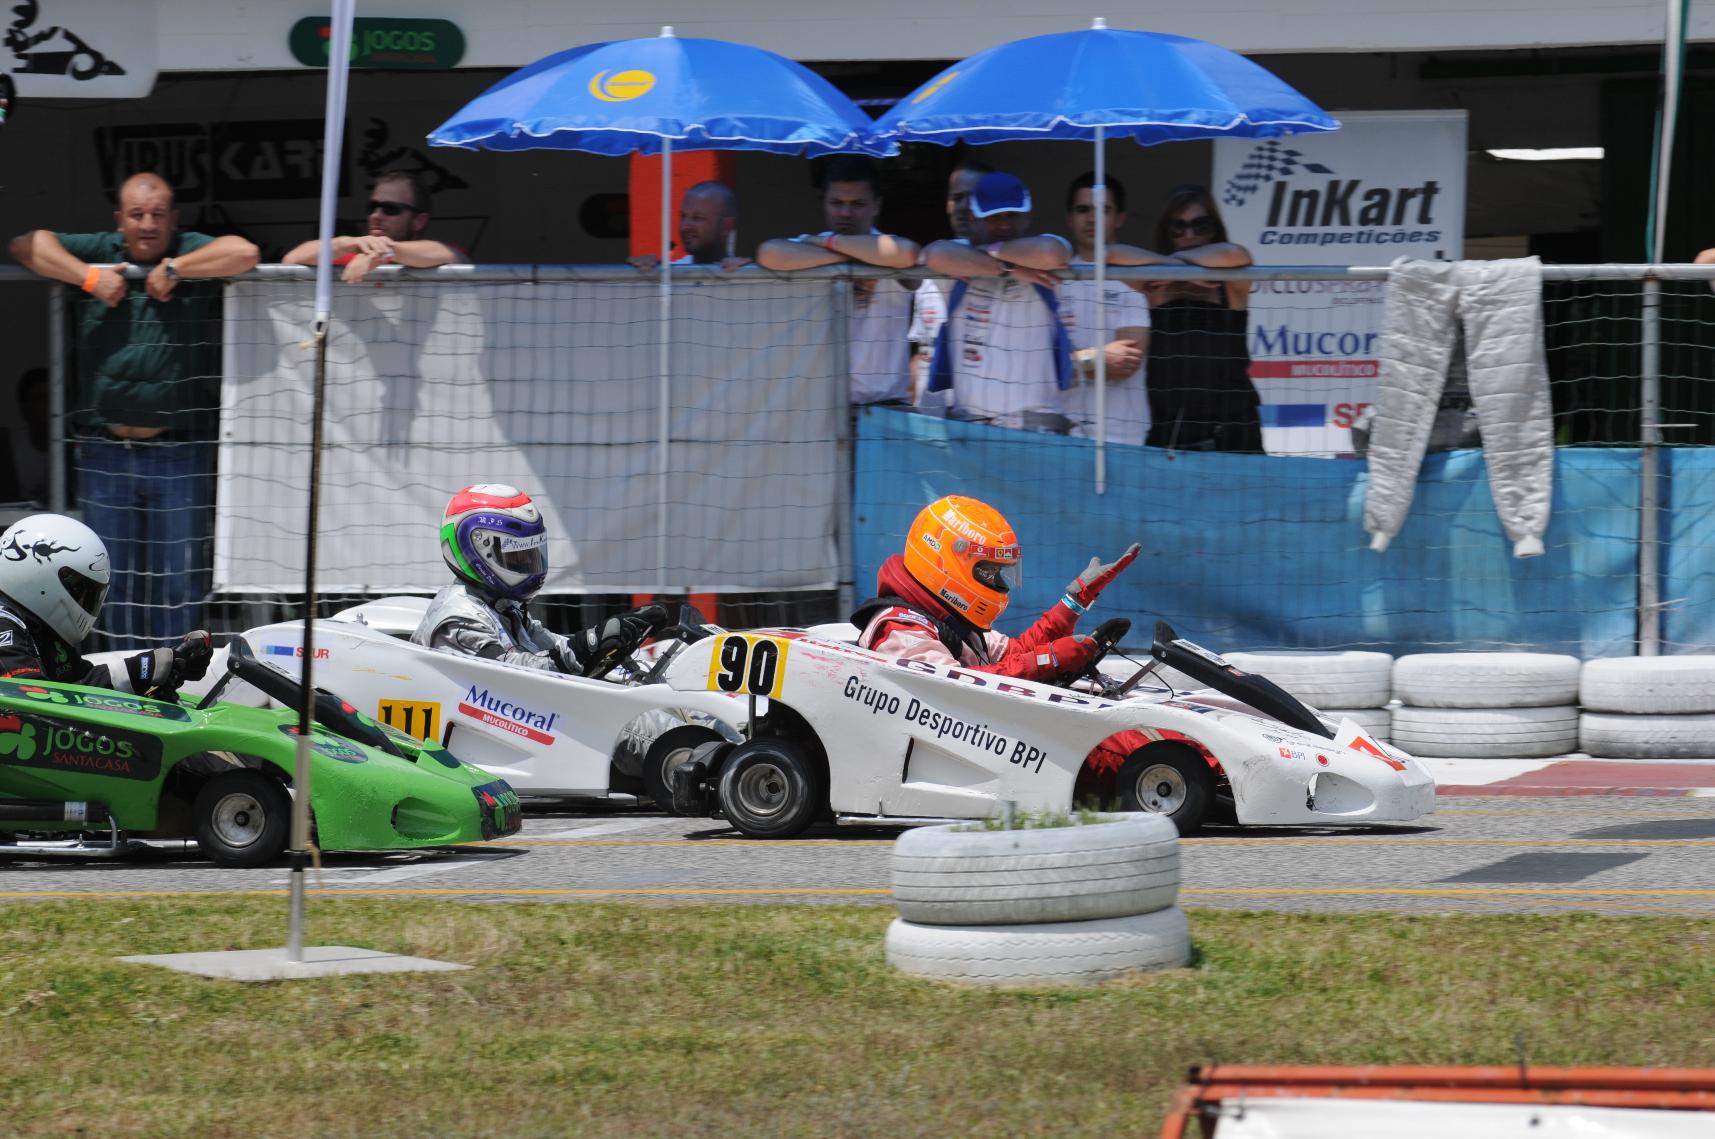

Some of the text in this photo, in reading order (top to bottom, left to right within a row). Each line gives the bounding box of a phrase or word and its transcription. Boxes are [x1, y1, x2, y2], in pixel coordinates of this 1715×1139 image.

[362, 30, 436, 55] JOGOS
[220, 140, 326, 180] KAR
[1265, 180, 1441, 227] InKart
[1250, 325, 1379, 355] Mucor
[941, 509, 987, 545] Marlboro
[940, 588, 969, 612] Marlboro
[295, 647, 330, 660] SUR
[717, 635, 779, 696] 90
[74, 694, 161, 713] JOGOS
[465, 685, 556, 732] Mucoral
[843, 675, 1047, 774] Grupo Desportivo BPI
[42, 727, 136, 758] JOGOS
